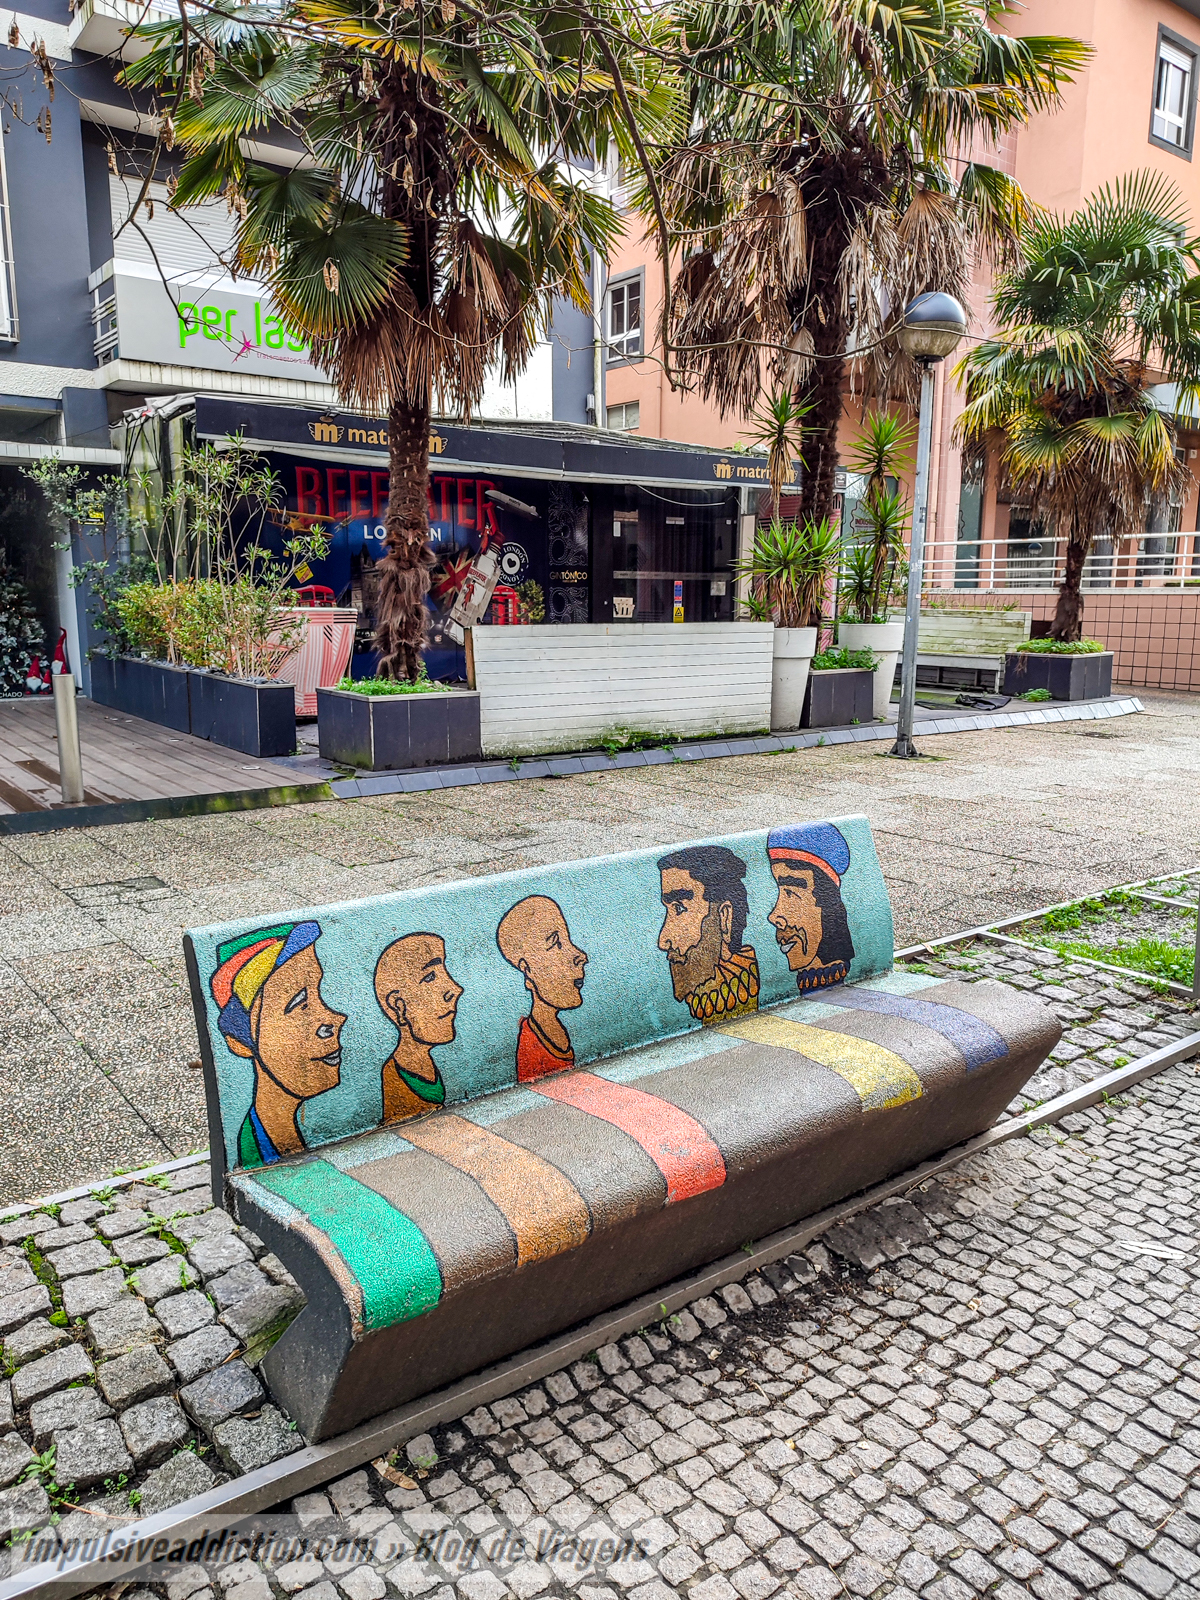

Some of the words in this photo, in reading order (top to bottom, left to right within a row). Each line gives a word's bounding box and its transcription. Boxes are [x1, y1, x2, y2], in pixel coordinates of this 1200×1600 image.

[178, 302, 238, 348] per
[254, 301, 333, 355] las
[348, 428, 390, 446] mat
[736, 466, 772, 480] matri
[295, 466, 498, 536] BEEFTER
[363, 525, 442, 542] LON
[502, 545, 527, 564] LONDON
